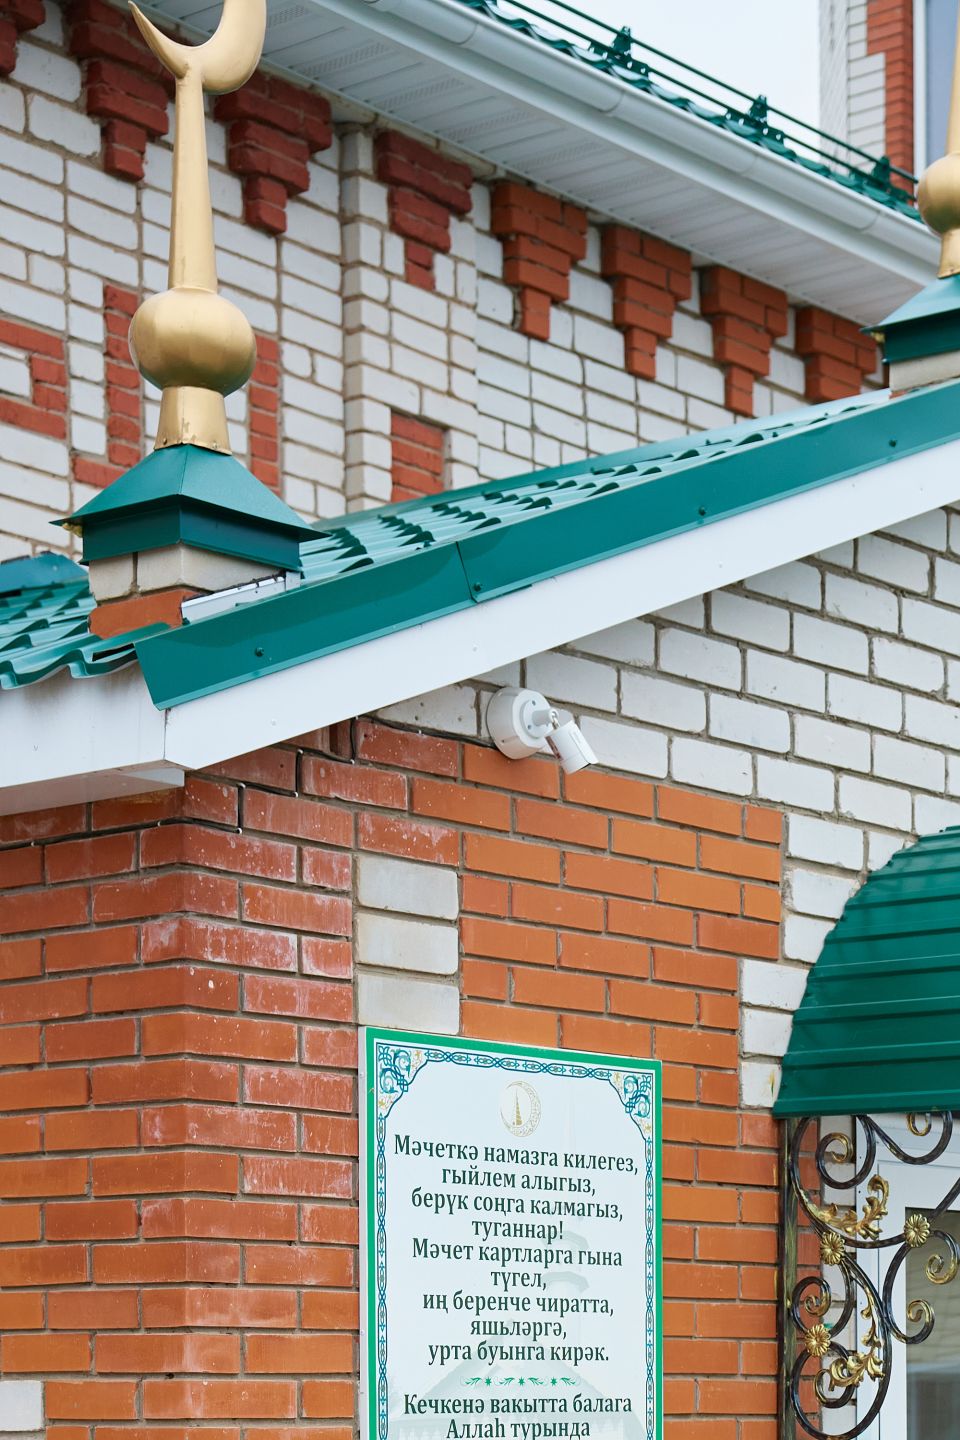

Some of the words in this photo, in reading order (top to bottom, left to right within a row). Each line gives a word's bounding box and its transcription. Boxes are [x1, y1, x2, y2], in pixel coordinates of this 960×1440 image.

[395, 1134, 478, 1160] Мәчеткә
[484, 1147, 558, 1166] намазга
[564, 1154, 637, 1175] килегез,
[442, 1165, 515, 1188] гыйлем
[521, 1175, 595, 1196] алыгыз,
[412, 1187, 468, 1215] берүк
[474, 1196, 524, 1216] соңга
[531, 1200, 622, 1222] калмагыз,
[472, 1221, 563, 1245] туганнар!
[413, 1238, 473, 1260] Мәчет
[479, 1246, 573, 1269] картларга
[579, 1251, 622, 1266] гына
[491, 1272, 546, 1292] түгел,
[423, 1295, 448, 1313] иң
[453, 1290, 530, 1316] беренче
[536, 1298, 613, 1318] чиратта,
[471, 1321, 566, 1342] яшьләргә,
[429, 1345, 472, 1365] урта
[478, 1340, 545, 1366] буынга
[551, 1347, 608, 1366] кирәк.
[404, 1394, 484, 1414] Кечкенә
[490, 1399, 568, 1413] вакытта
[573, 1393, 631, 1412] балага
[446, 1418, 505, 1438] Аллаһ
